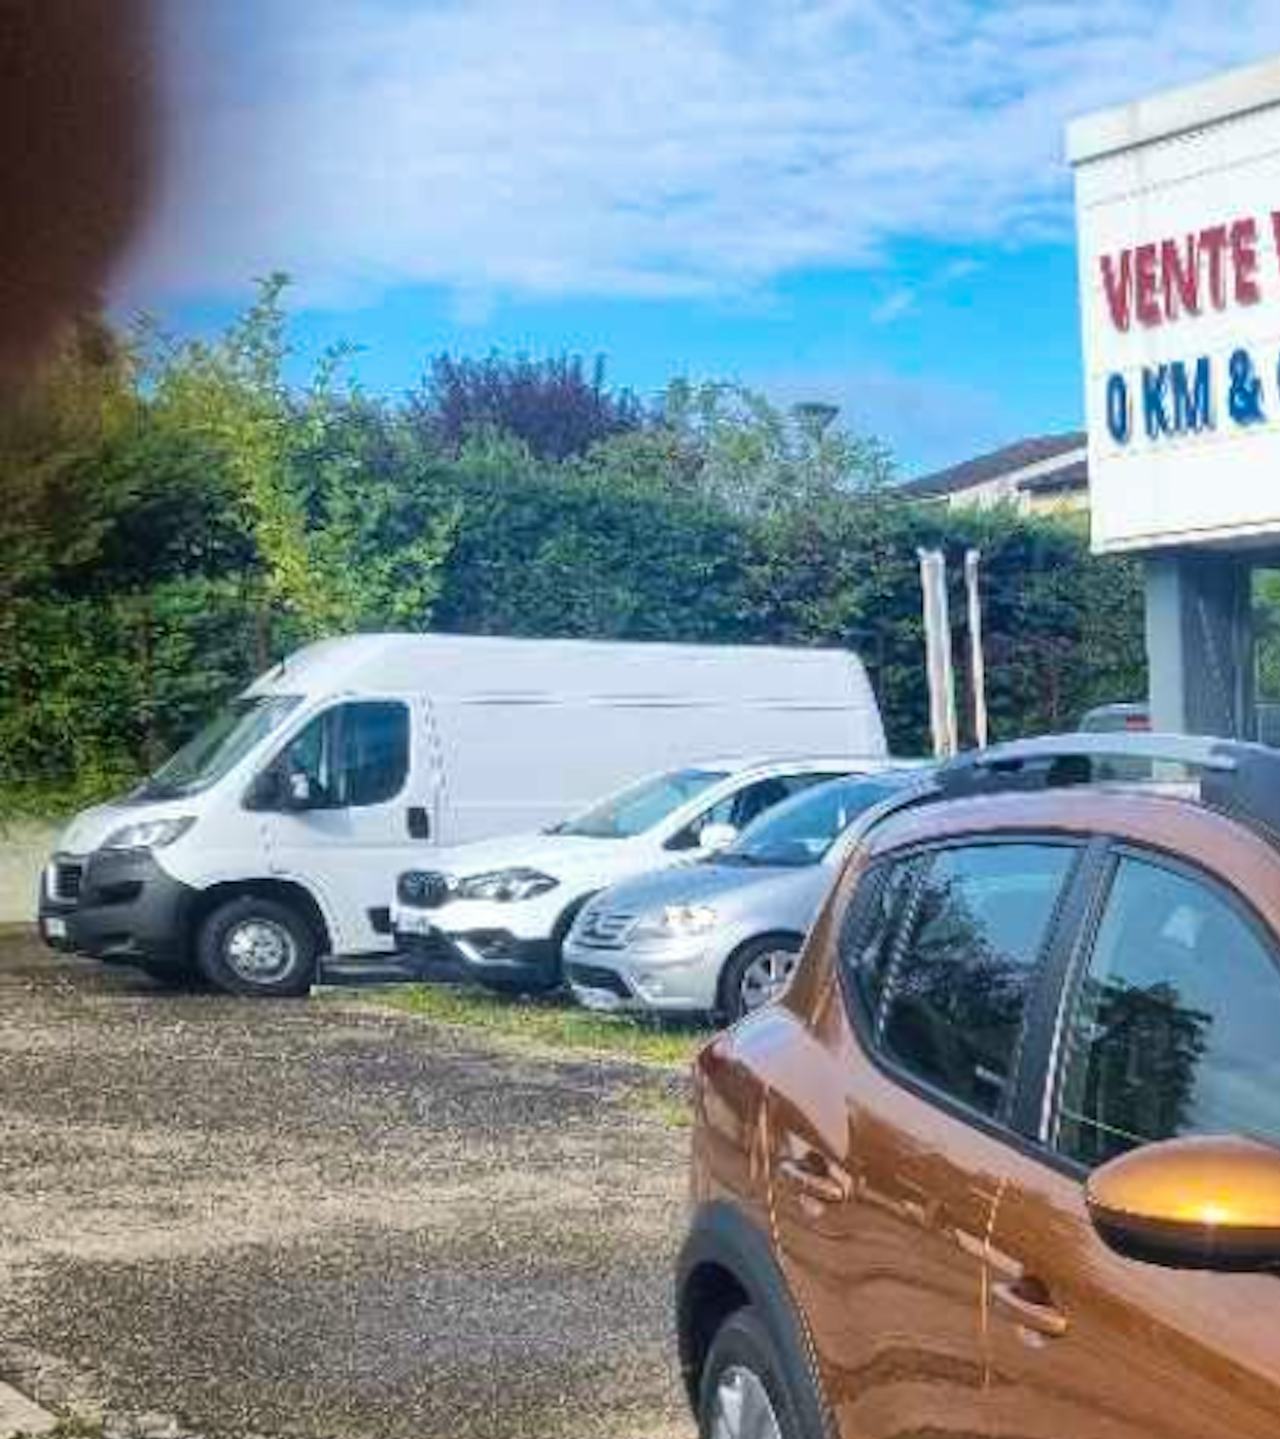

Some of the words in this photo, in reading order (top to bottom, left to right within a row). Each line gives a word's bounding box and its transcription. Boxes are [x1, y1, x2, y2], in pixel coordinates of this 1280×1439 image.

[1101, 217, 1260, 333] VENTE
[1106, 371, 1131, 444] 0
[1142, 357, 1216, 439] KM
[1228, 348, 1266, 427] &
